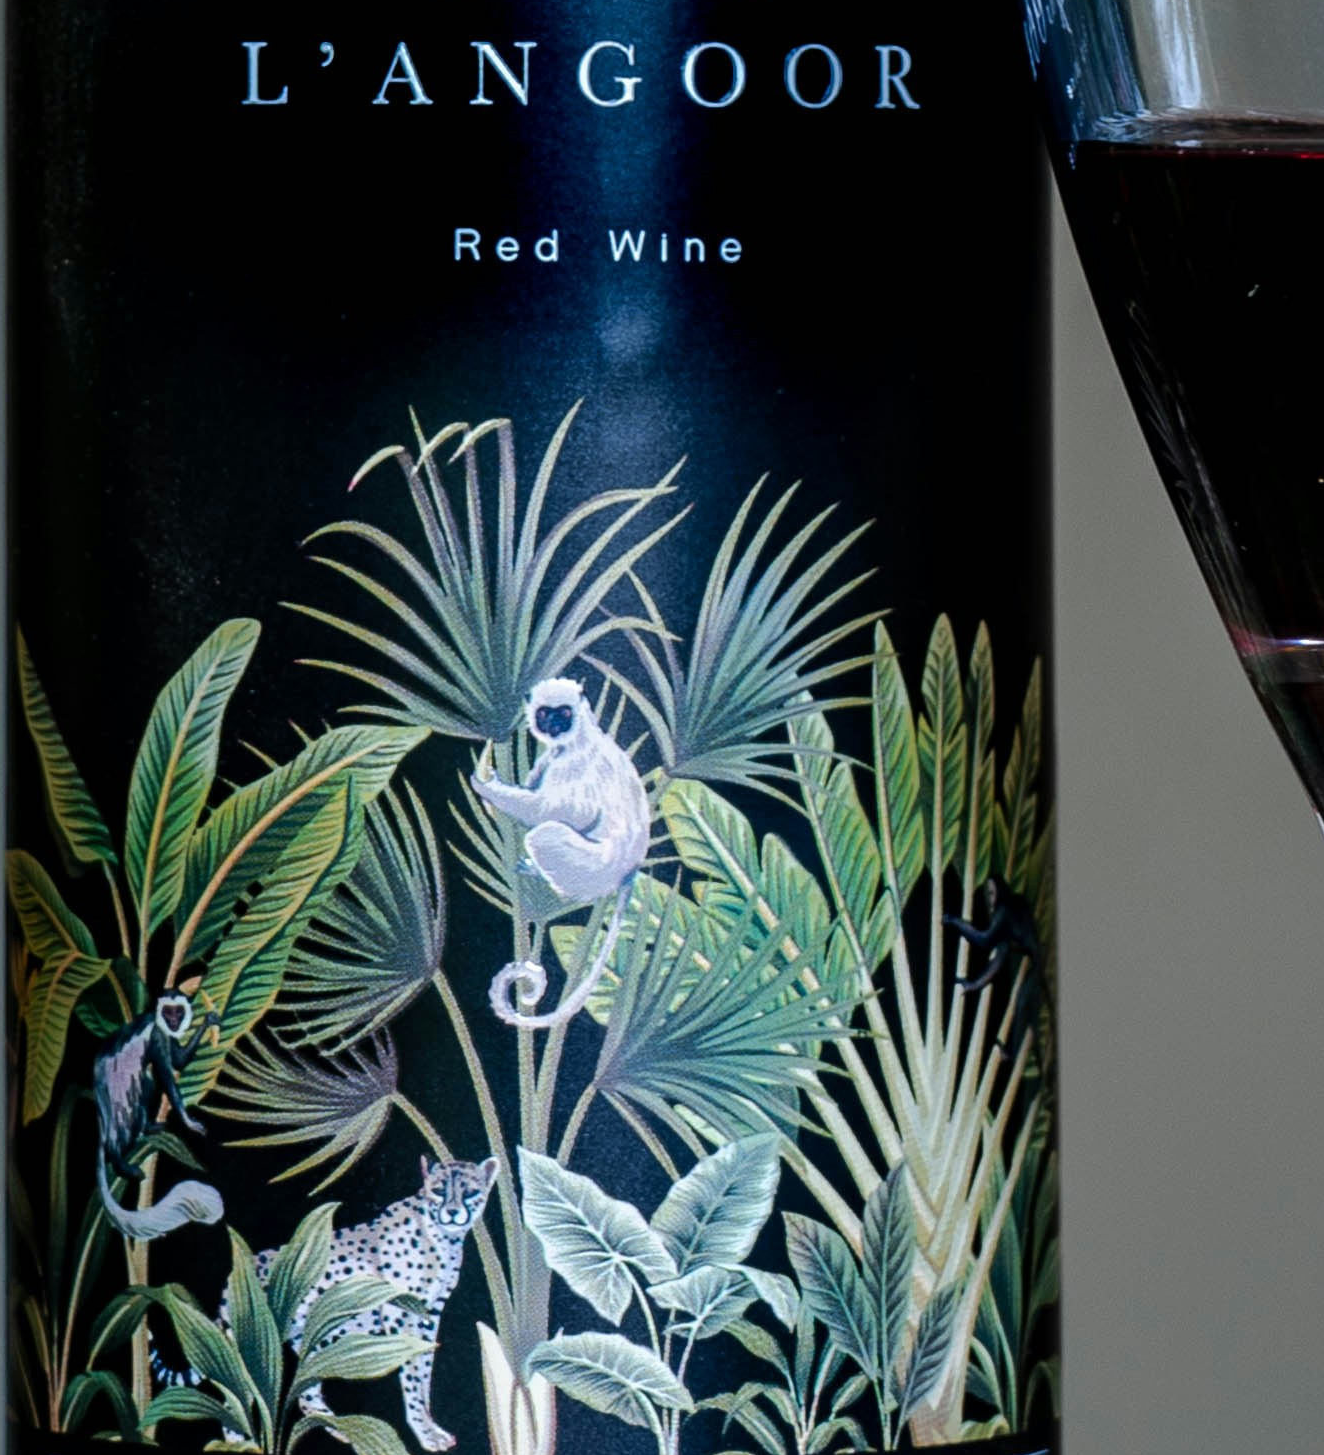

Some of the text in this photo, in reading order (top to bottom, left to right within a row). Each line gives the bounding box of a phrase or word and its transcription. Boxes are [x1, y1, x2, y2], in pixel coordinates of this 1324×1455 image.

[241, 39, 921, 110] L’ANGOOR
[453, 226, 744, 263] Red Wine
